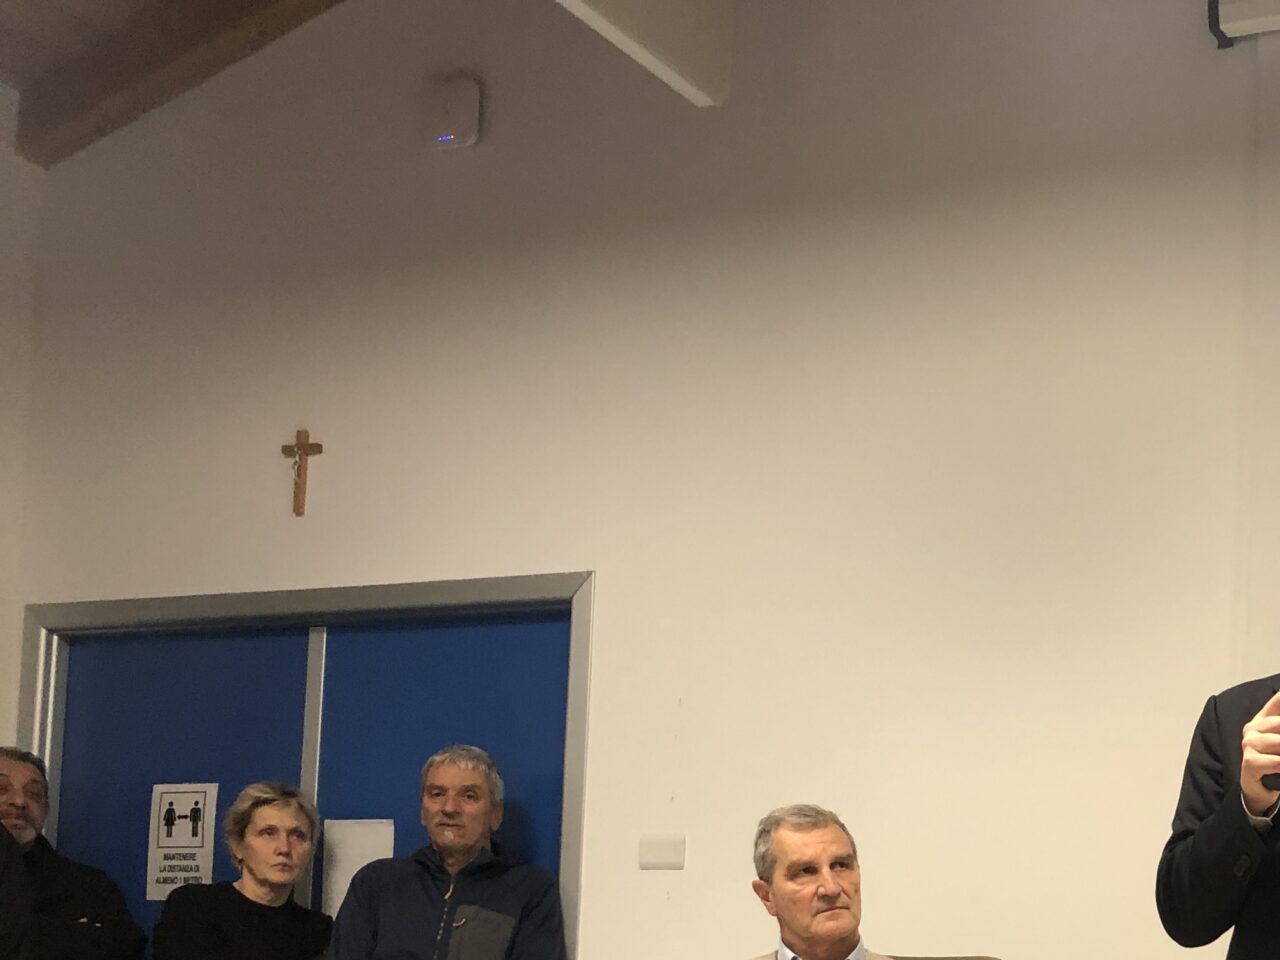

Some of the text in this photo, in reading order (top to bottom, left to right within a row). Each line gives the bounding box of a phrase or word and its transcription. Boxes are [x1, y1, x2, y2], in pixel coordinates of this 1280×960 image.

[163, 852, 197, 861] MANTENERE
[159, 864, 166, 873] LA
[167, 864, 193, 873] DISTANZA
[155, 876, 178, 884] ALMENO
